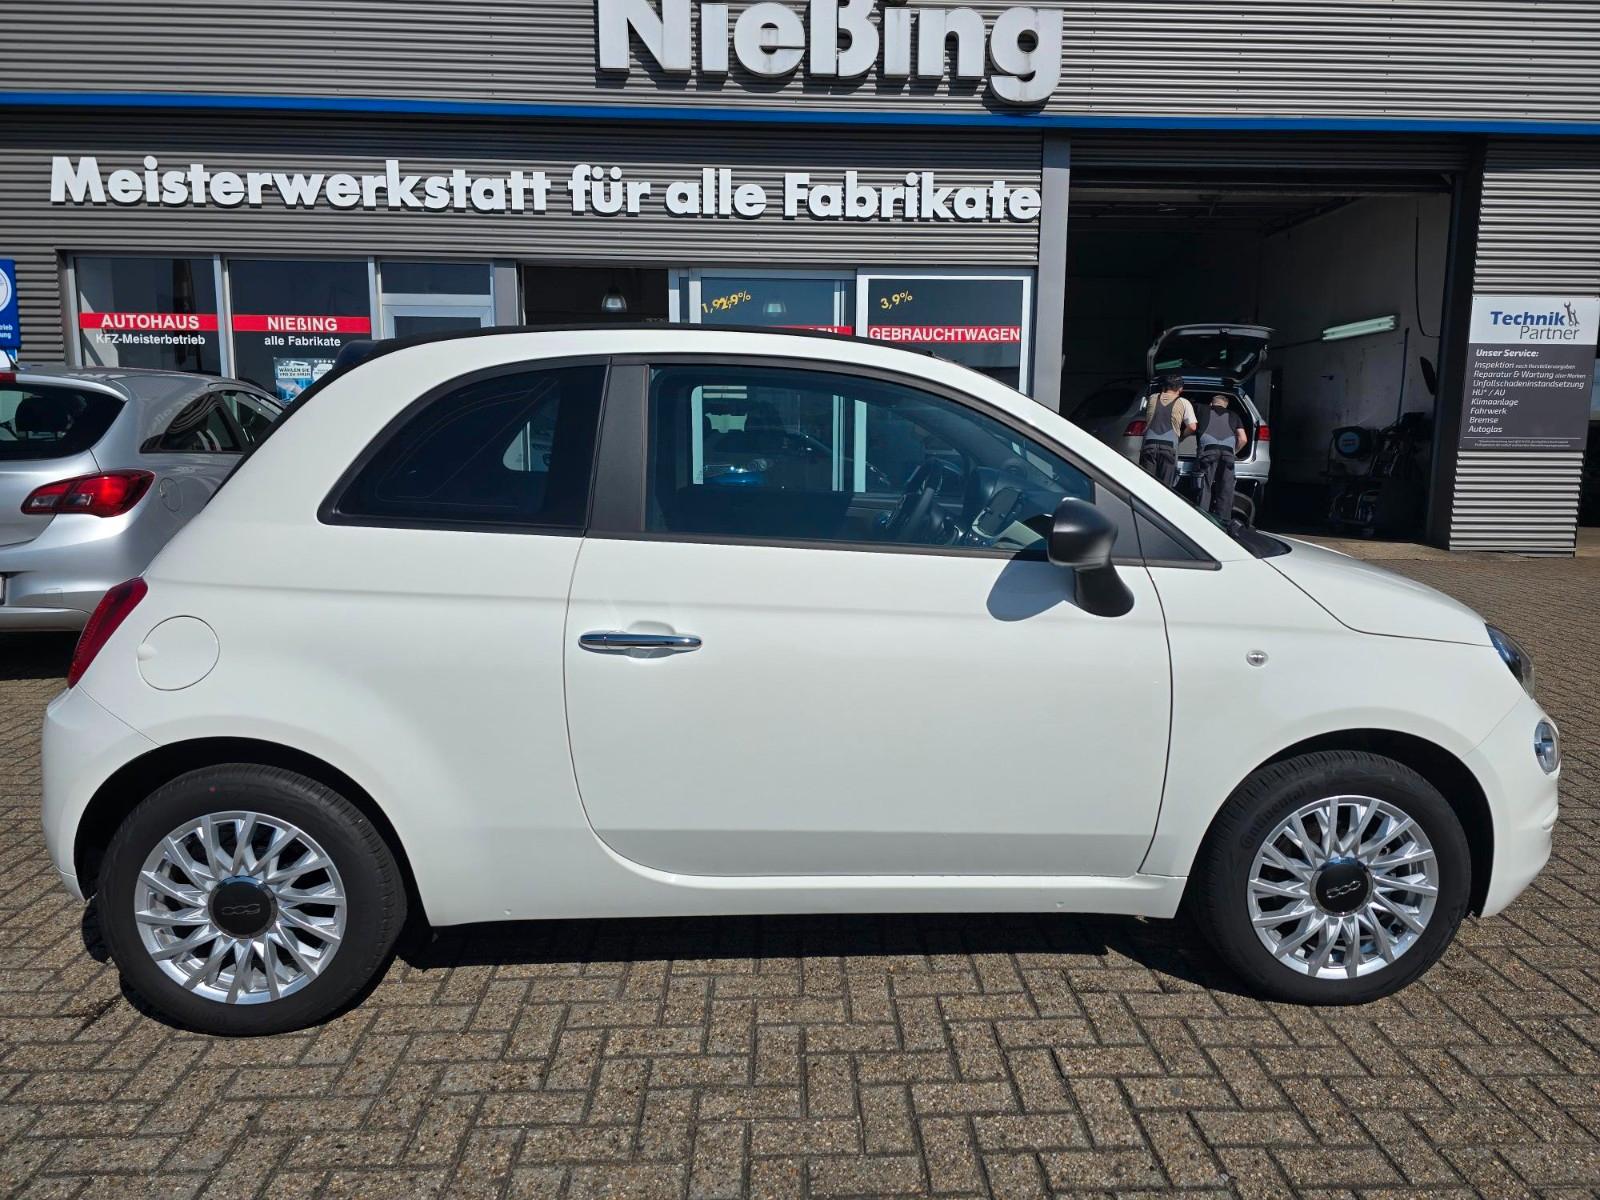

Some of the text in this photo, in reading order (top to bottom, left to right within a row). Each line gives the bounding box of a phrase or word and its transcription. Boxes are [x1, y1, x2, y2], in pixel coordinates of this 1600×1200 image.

[49, 155, 1042, 222] Meisterwerkstatt für alle Fabrikate
[880, 290, 913, 310] 3,9%
[100, 314, 200, 330] AUTOHAUS
[267, 317, 338, 332] NIEßING
[1490, 311, 1565, 326] Technik
[869, 327, 1020, 341] GEBRAUCHTWAGEN
[1519, 325, 1580, 340] Partner
[96, 333, 206, 346] KFZ-Meisterbetrieb
[264, 335, 341, 348] alle Fabrikate
[1476, 349, 1540, 358] Unser Service:
[1474, 361, 1514, 370] Inspektion
[1473, 371, 1512, 379] Reparatur
[1521, 371, 1554, 380] Wartung
[1473, 380, 1585, 390] Unfallschadeninstandsetzung
[1471, 398, 1519, 406] Klimaanlage
[1470, 407, 1507, 415] Fahrwerk
[1469, 416, 1499, 424] Bremse
[1468, 425, 1503, 434] Autoglas
